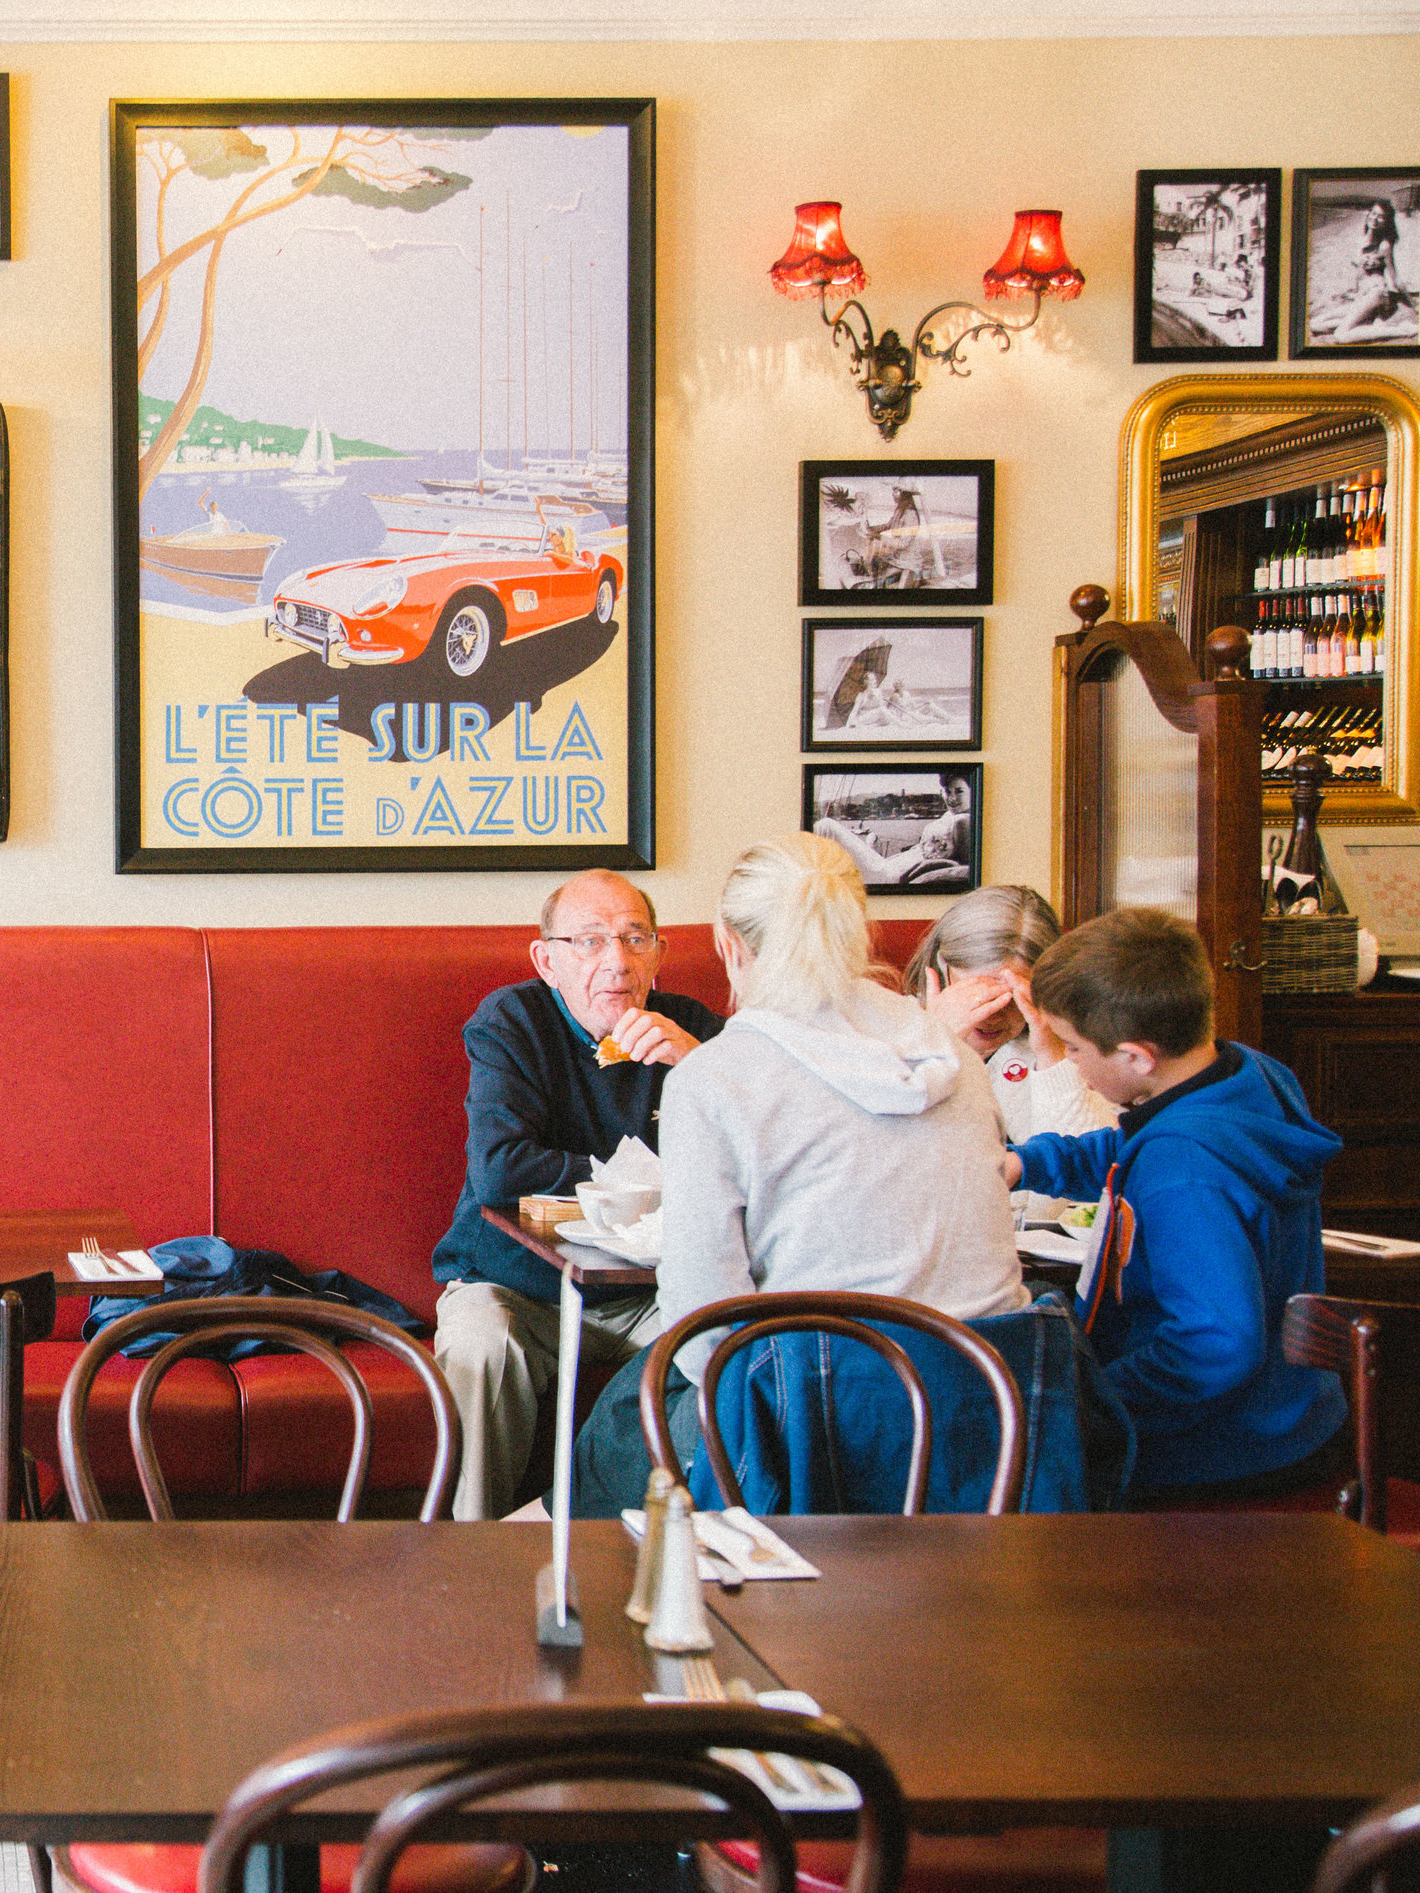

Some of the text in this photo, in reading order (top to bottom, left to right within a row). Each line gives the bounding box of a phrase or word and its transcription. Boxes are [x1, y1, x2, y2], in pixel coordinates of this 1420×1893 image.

[165, 695, 604, 764] L'ÉTÉ SUR LA
[163, 766, 344, 839] CÔTE
